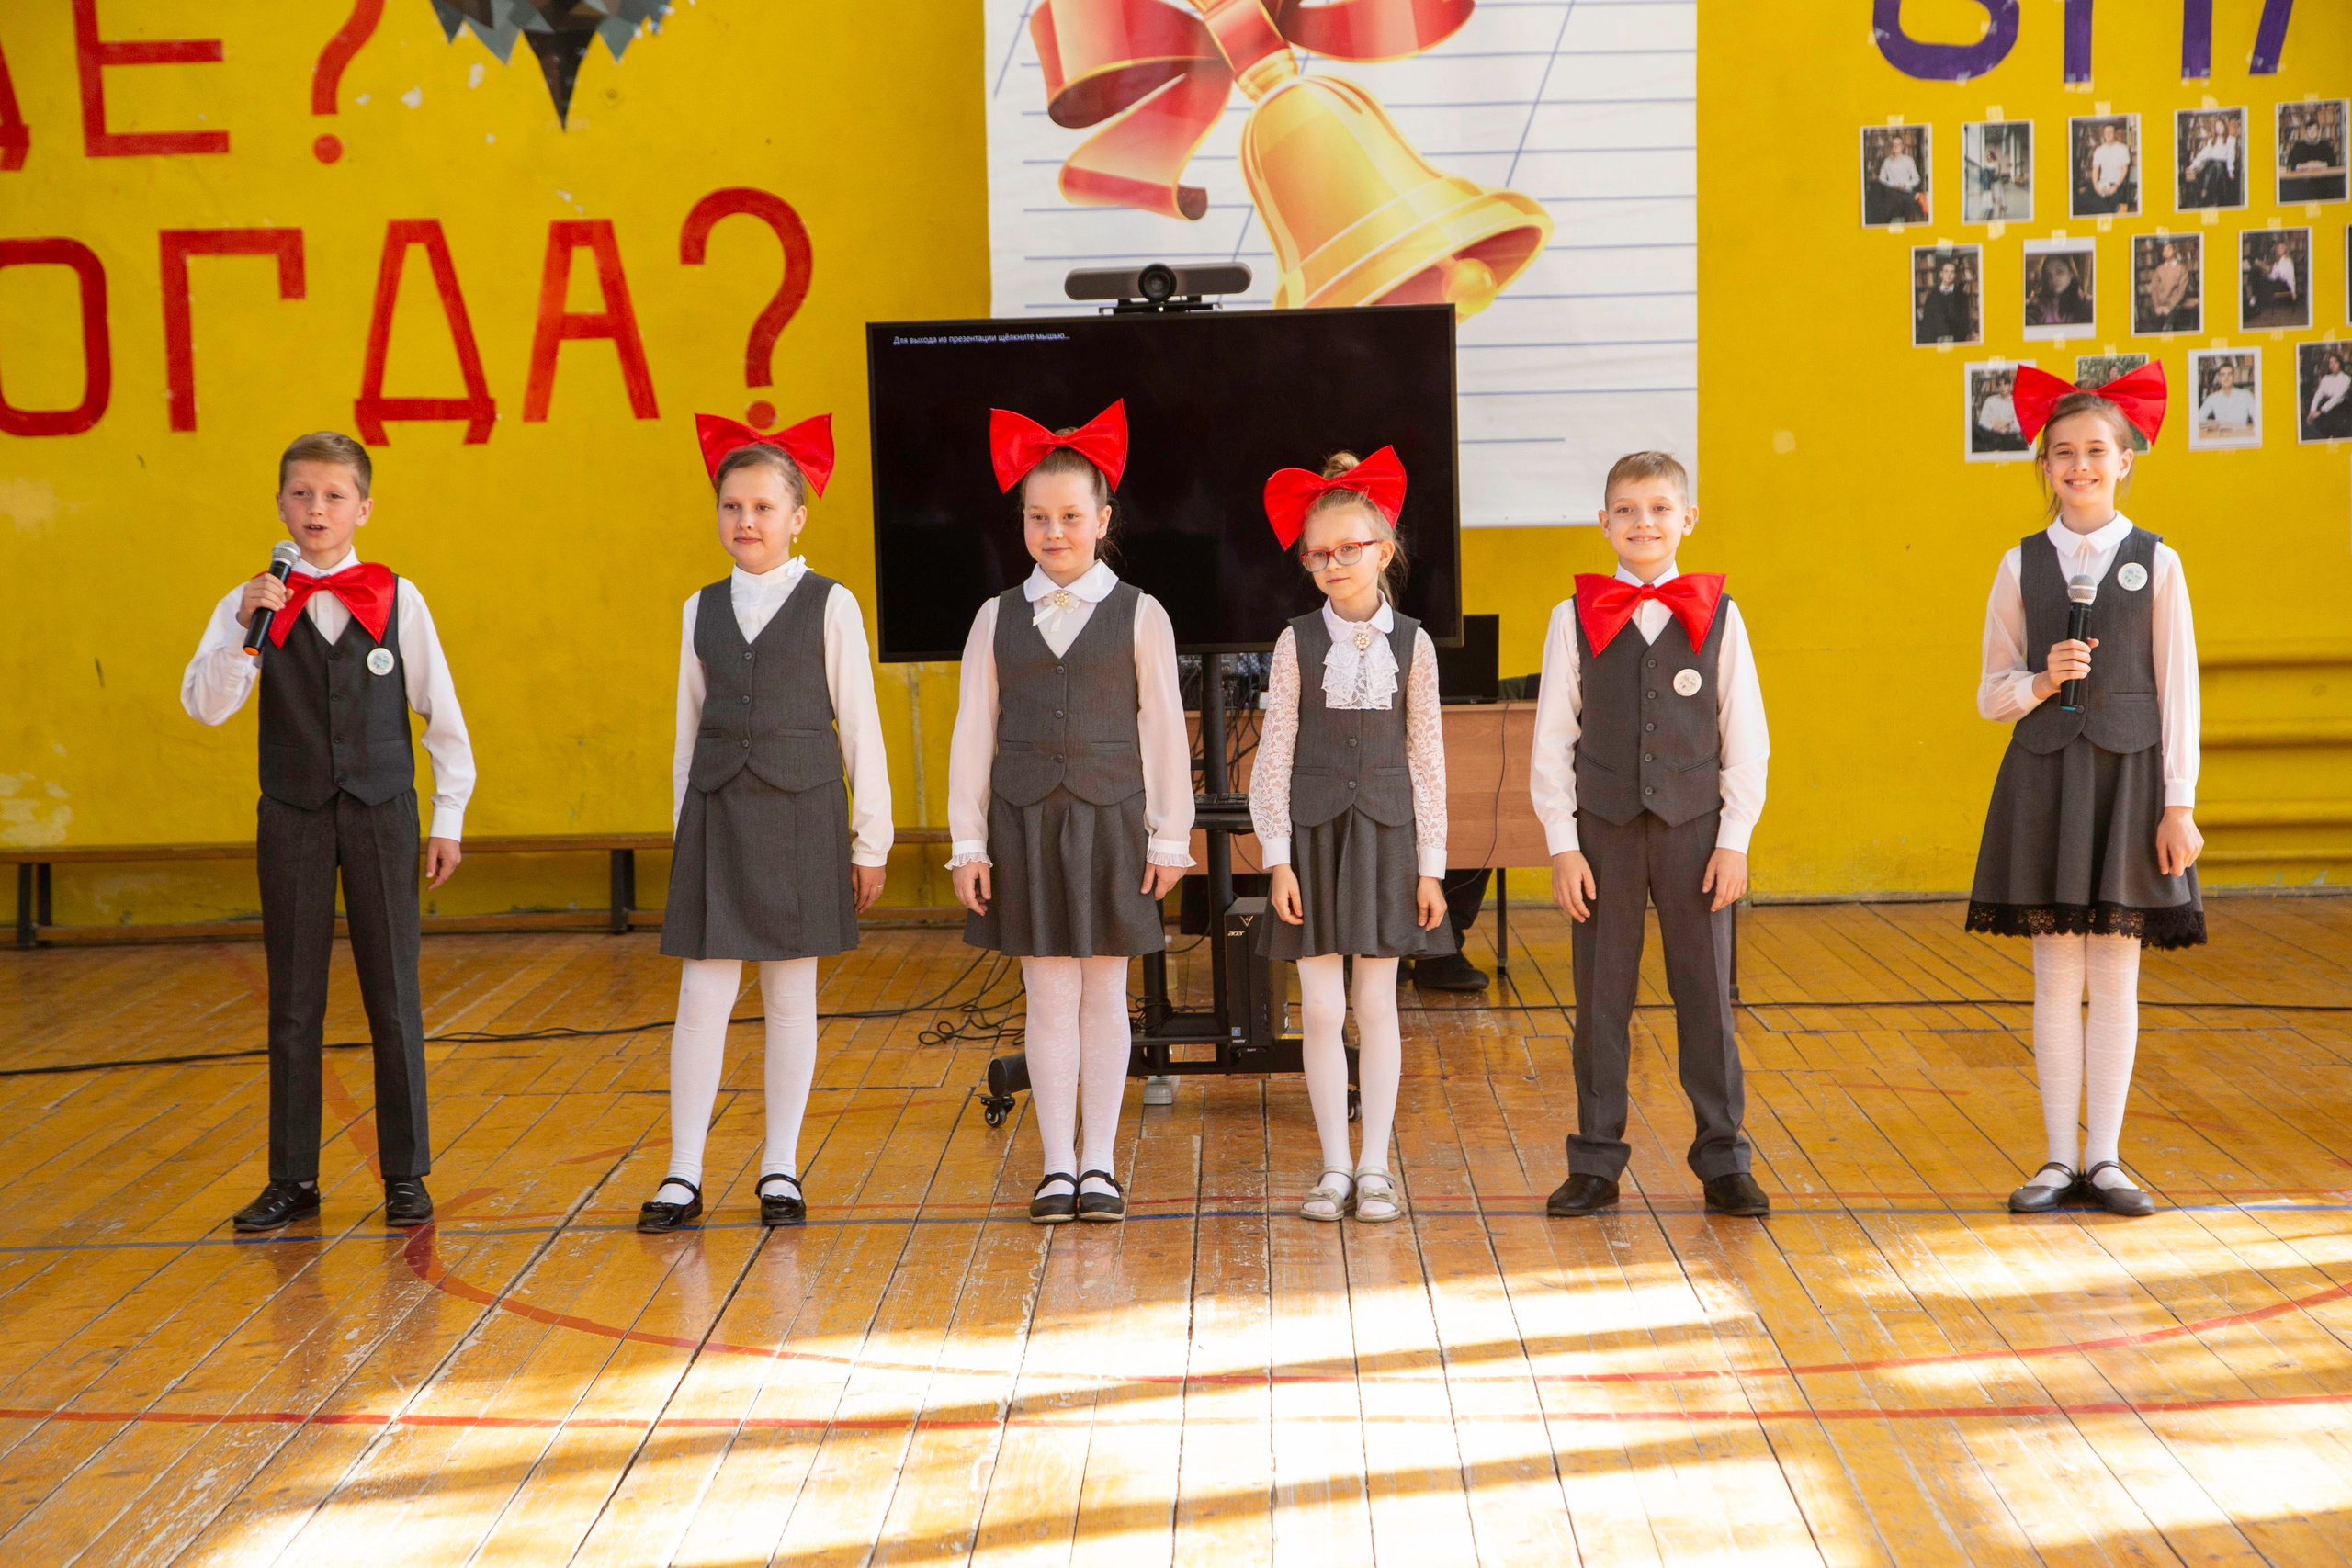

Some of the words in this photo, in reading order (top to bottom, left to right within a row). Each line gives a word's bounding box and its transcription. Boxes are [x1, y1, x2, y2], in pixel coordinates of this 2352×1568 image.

[893, 336, 908, 345] Для
[910, 336, 937, 344] выхода
[948, 334, 997, 344] презентации
[998, 333, 1035, 344] щёлкните
